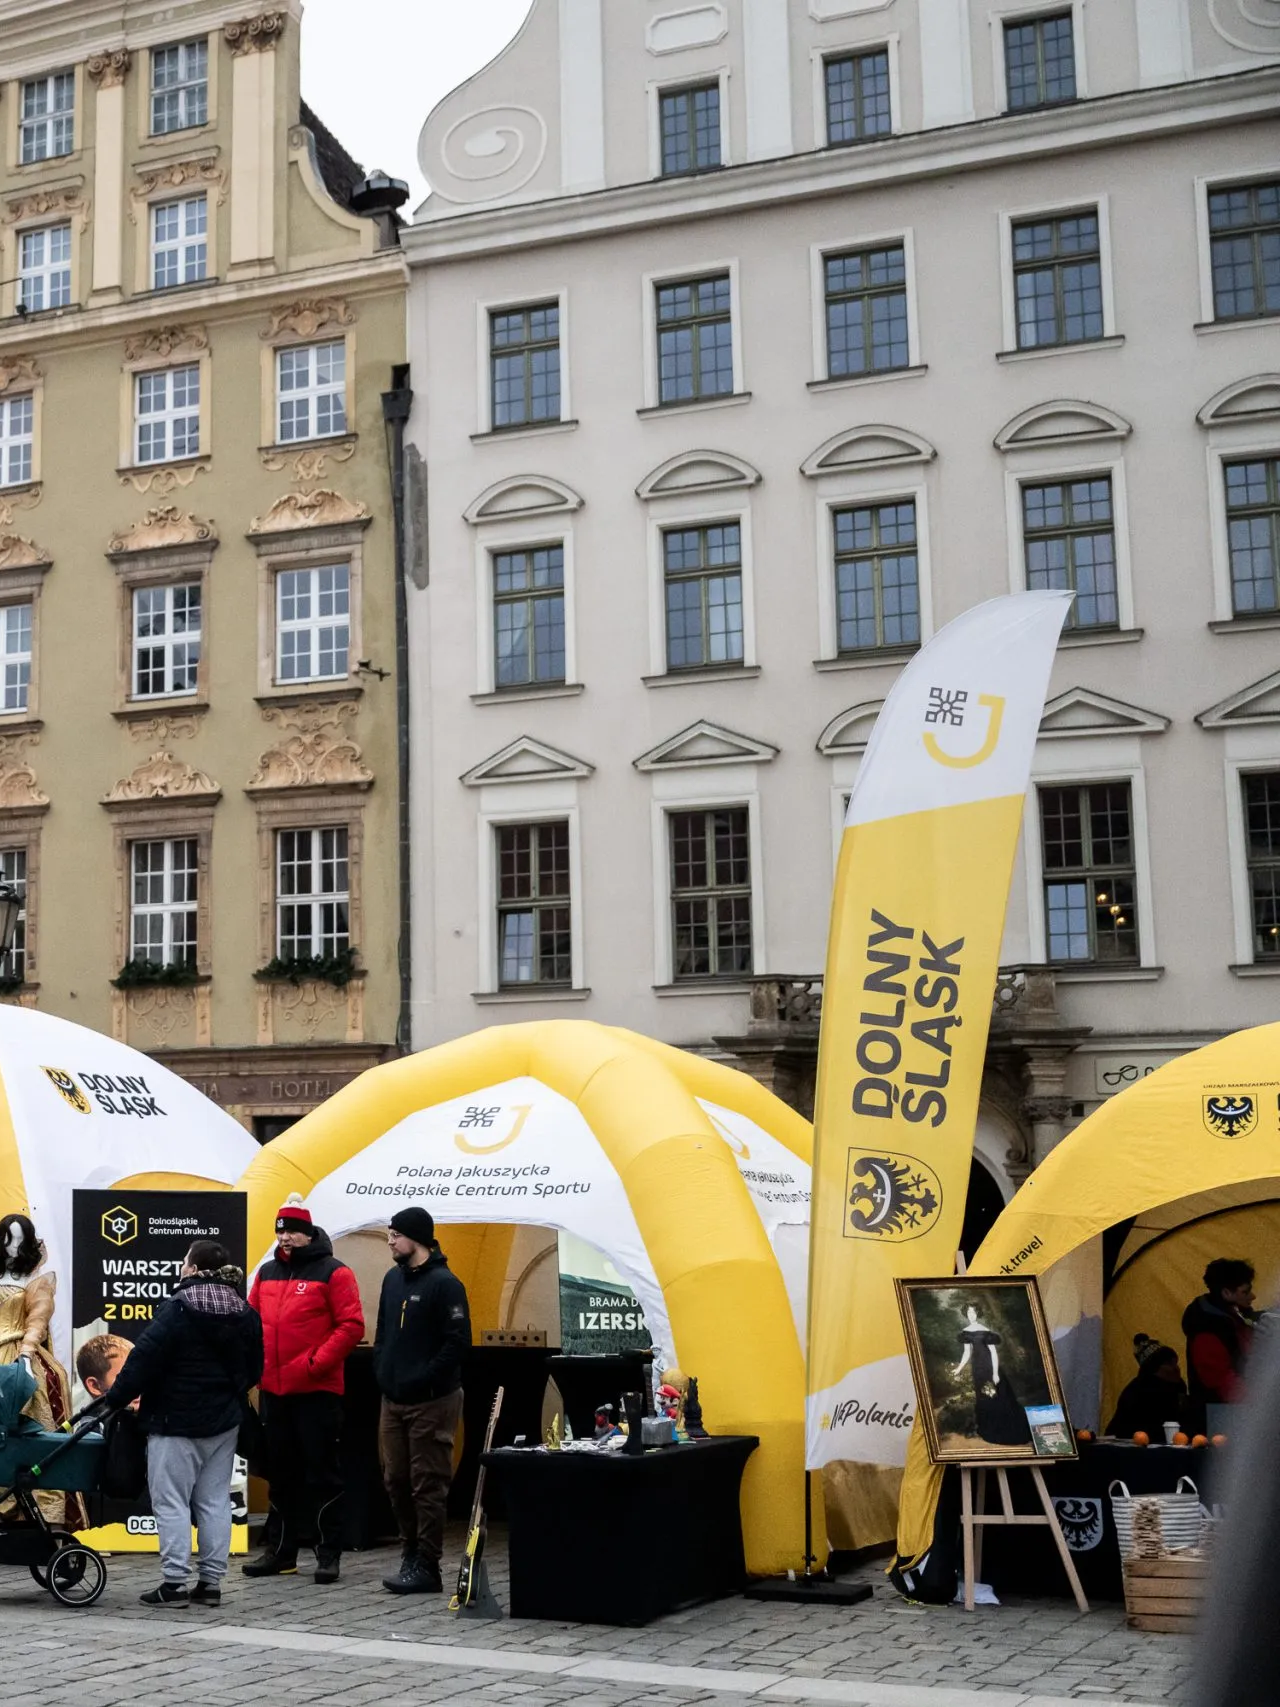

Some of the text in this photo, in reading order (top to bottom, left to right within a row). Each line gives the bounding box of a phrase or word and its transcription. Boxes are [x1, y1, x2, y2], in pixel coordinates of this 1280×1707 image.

[851, 908, 914, 1118] DOLNY
[892, 930, 965, 1128] ŚLĄSK
[77, 1072, 151, 1094] DOLNY
[270, 1078, 333, 1098] HOTEL
[95, 1090, 168, 1119] ŚLĄSK
[396, 1164, 550, 1180] Polana Jakuszycka
[346, 1182, 592, 1198] Dolnośląskie Centrum Sportu
[148, 1217, 198, 1226] Dolnośląskie
[148, 1227, 220, 1235] Centrum Druku 3D
[102, 1259, 184, 1277] WARSZT
[102, 1281, 108, 1298] I
[589, 1296, 629, 1307] BRAMA
[104, 1303, 117, 1320] Z
[579, 1312, 648, 1331] IZERSK
